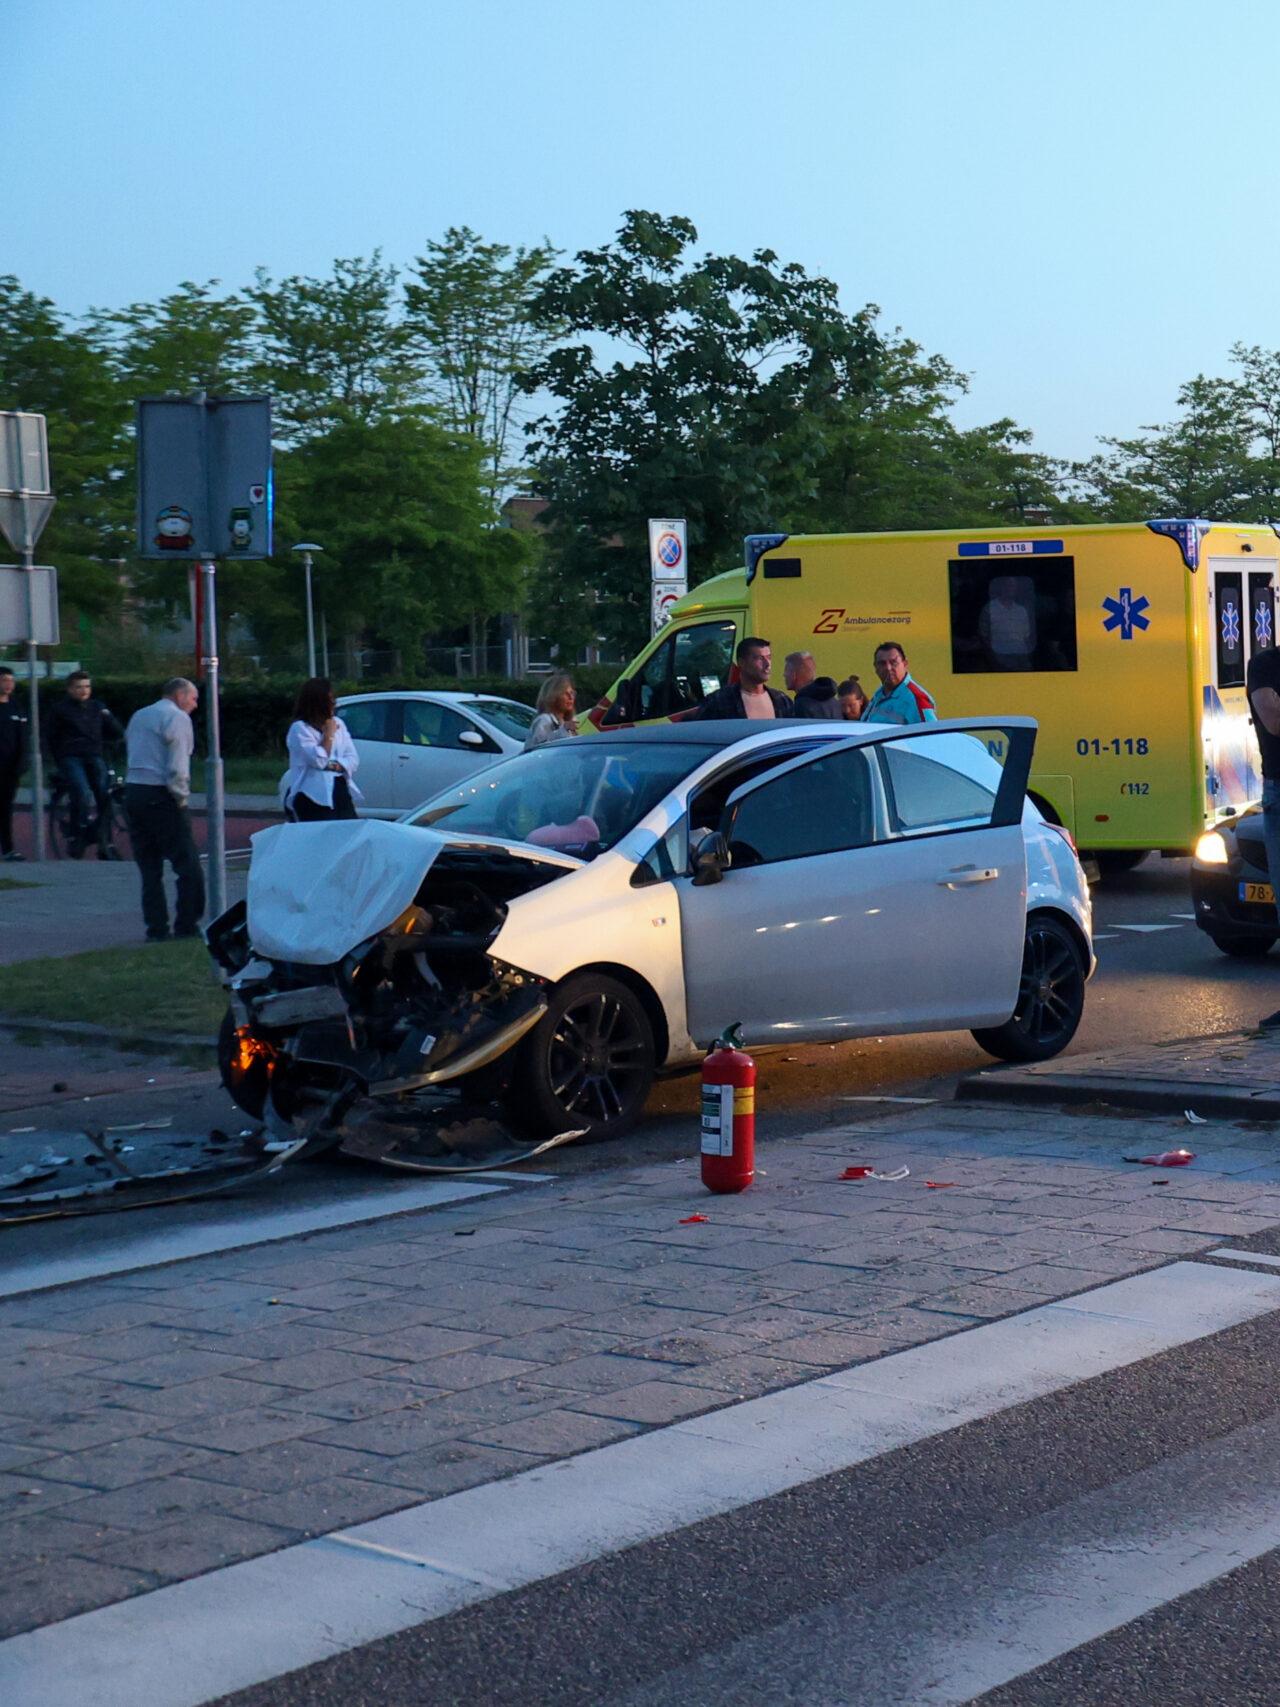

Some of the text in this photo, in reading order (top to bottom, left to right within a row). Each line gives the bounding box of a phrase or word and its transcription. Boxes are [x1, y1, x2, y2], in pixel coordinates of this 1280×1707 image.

[995, 543, 1026, 553] 01-118
[844, 616, 911, 625] Ambulancezorg
[1076, 738, 1149, 755] 01-118
